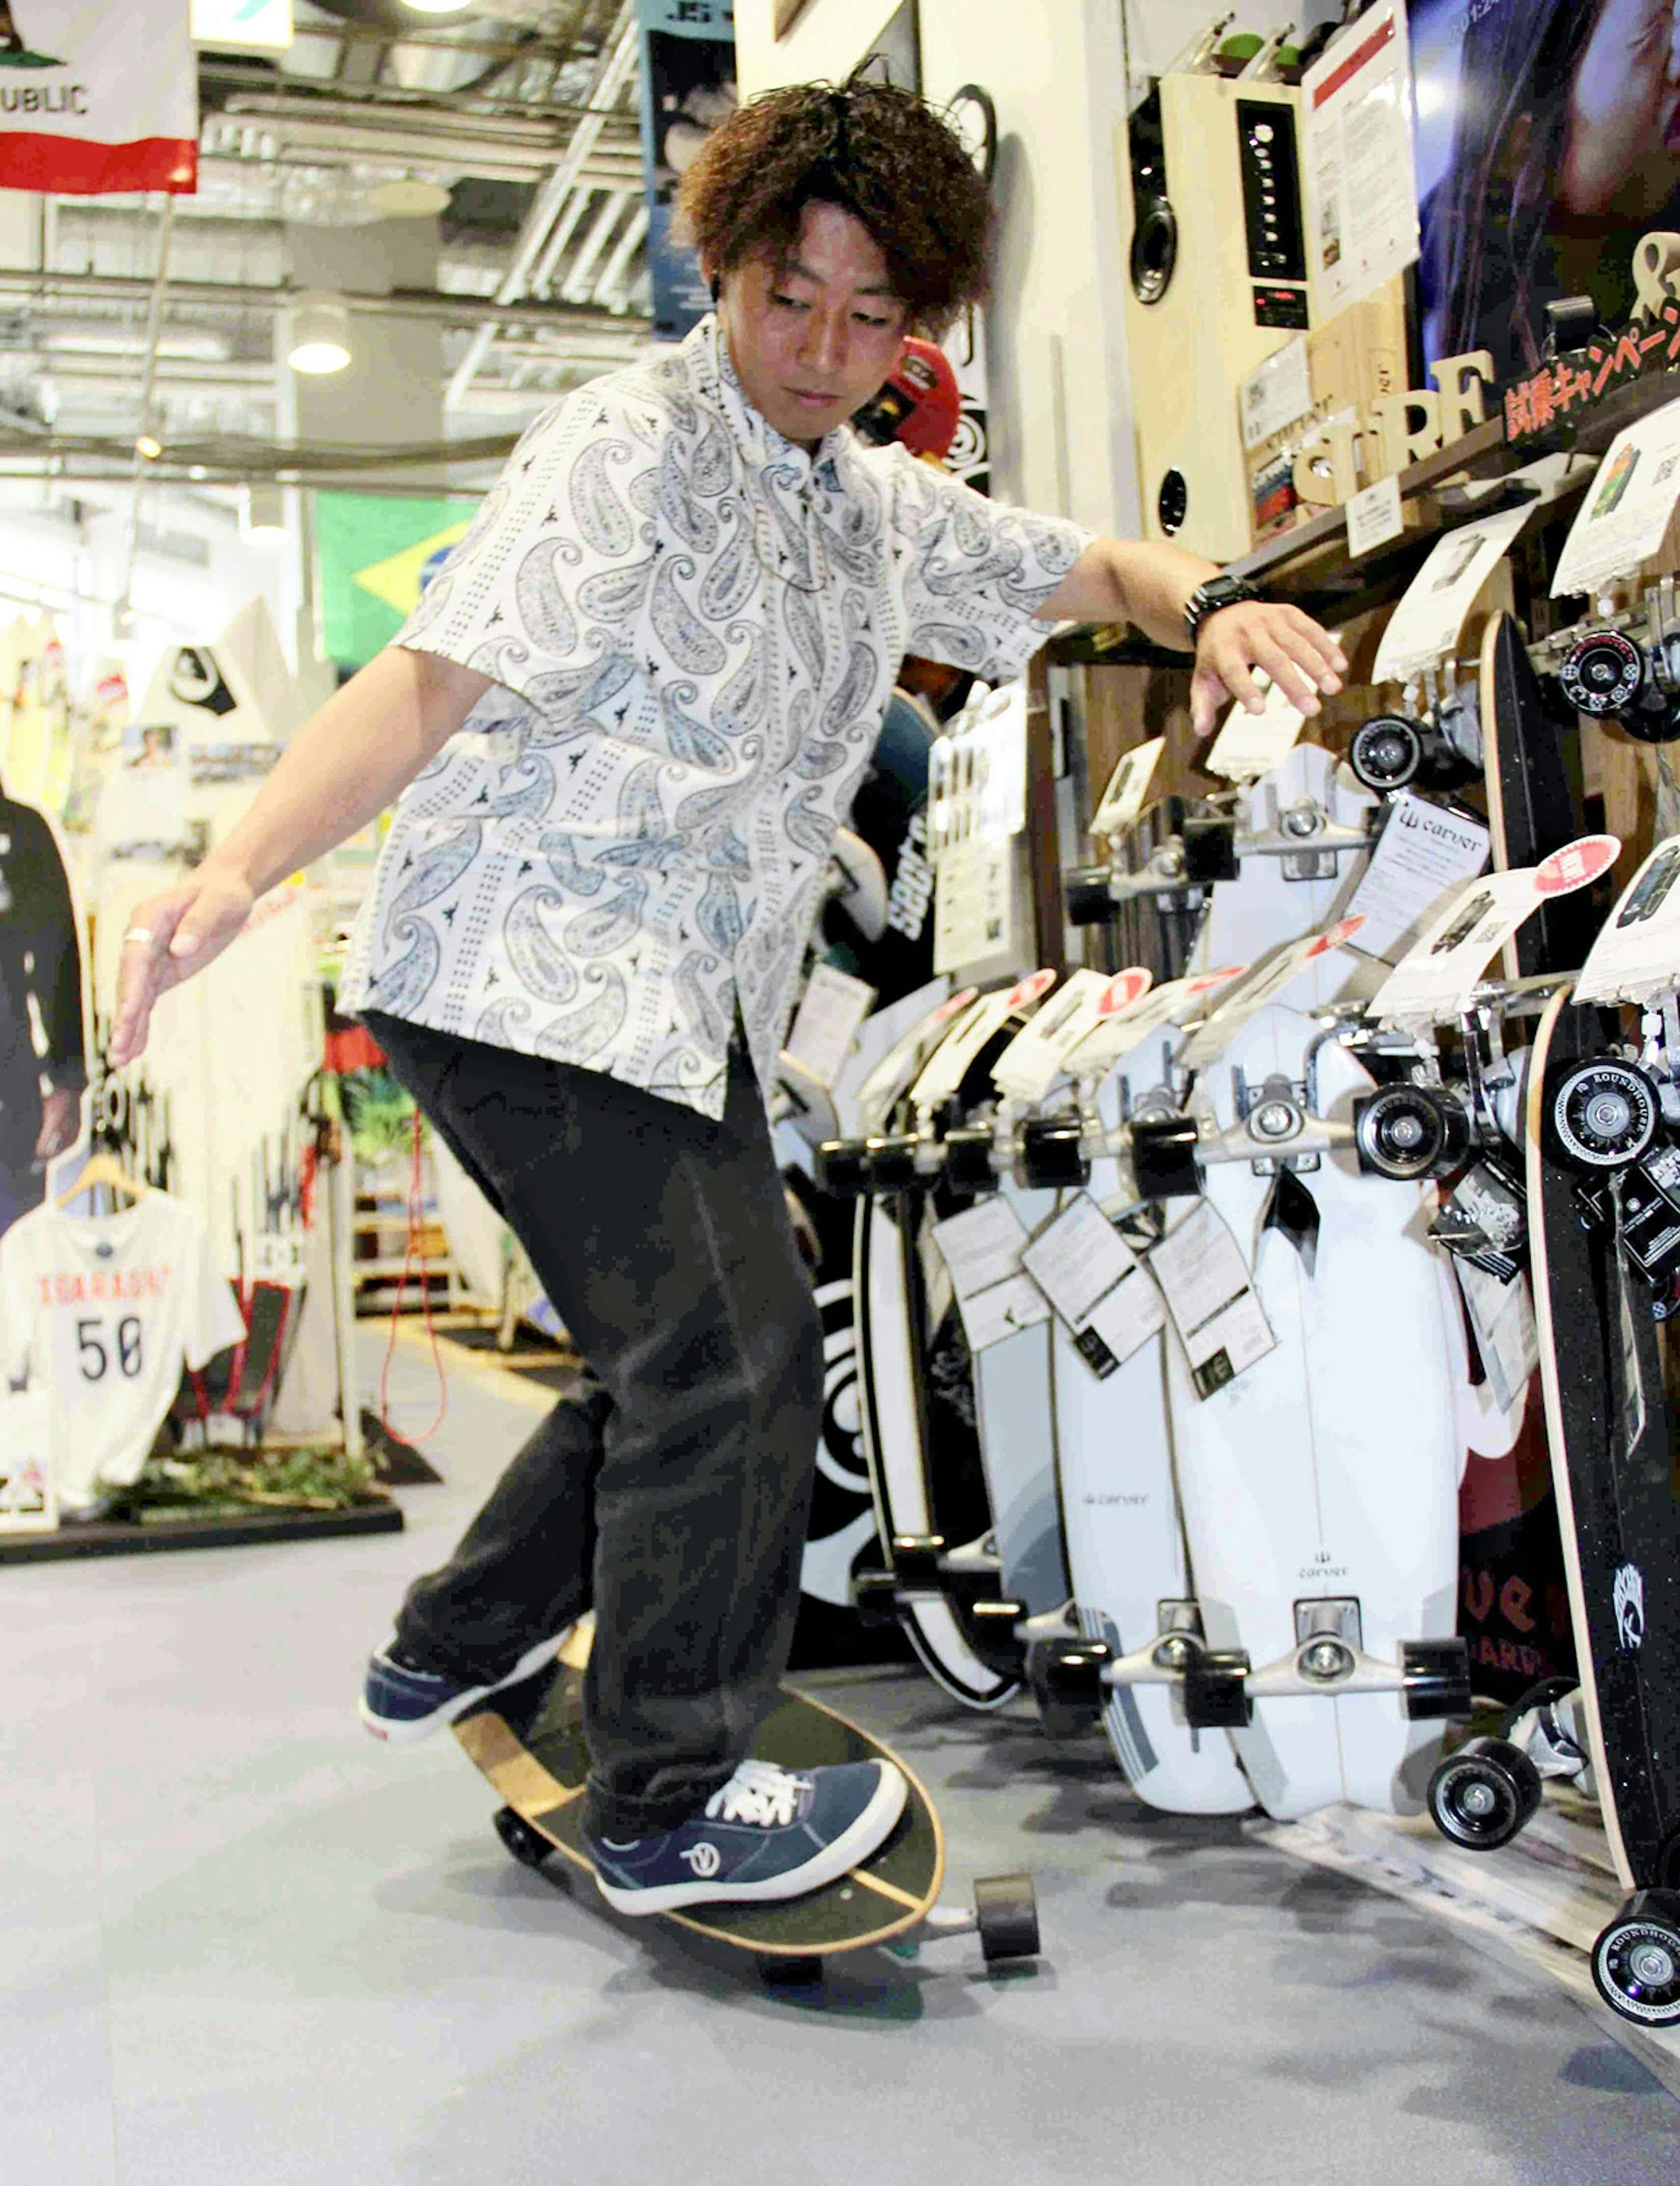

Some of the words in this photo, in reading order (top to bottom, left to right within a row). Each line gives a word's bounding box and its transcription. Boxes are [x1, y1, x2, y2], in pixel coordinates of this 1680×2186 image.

[1422, 818, 1482, 853] carver
[75, 1316, 142, 1381] 50
[1298, 1565, 1350, 1578] carver
